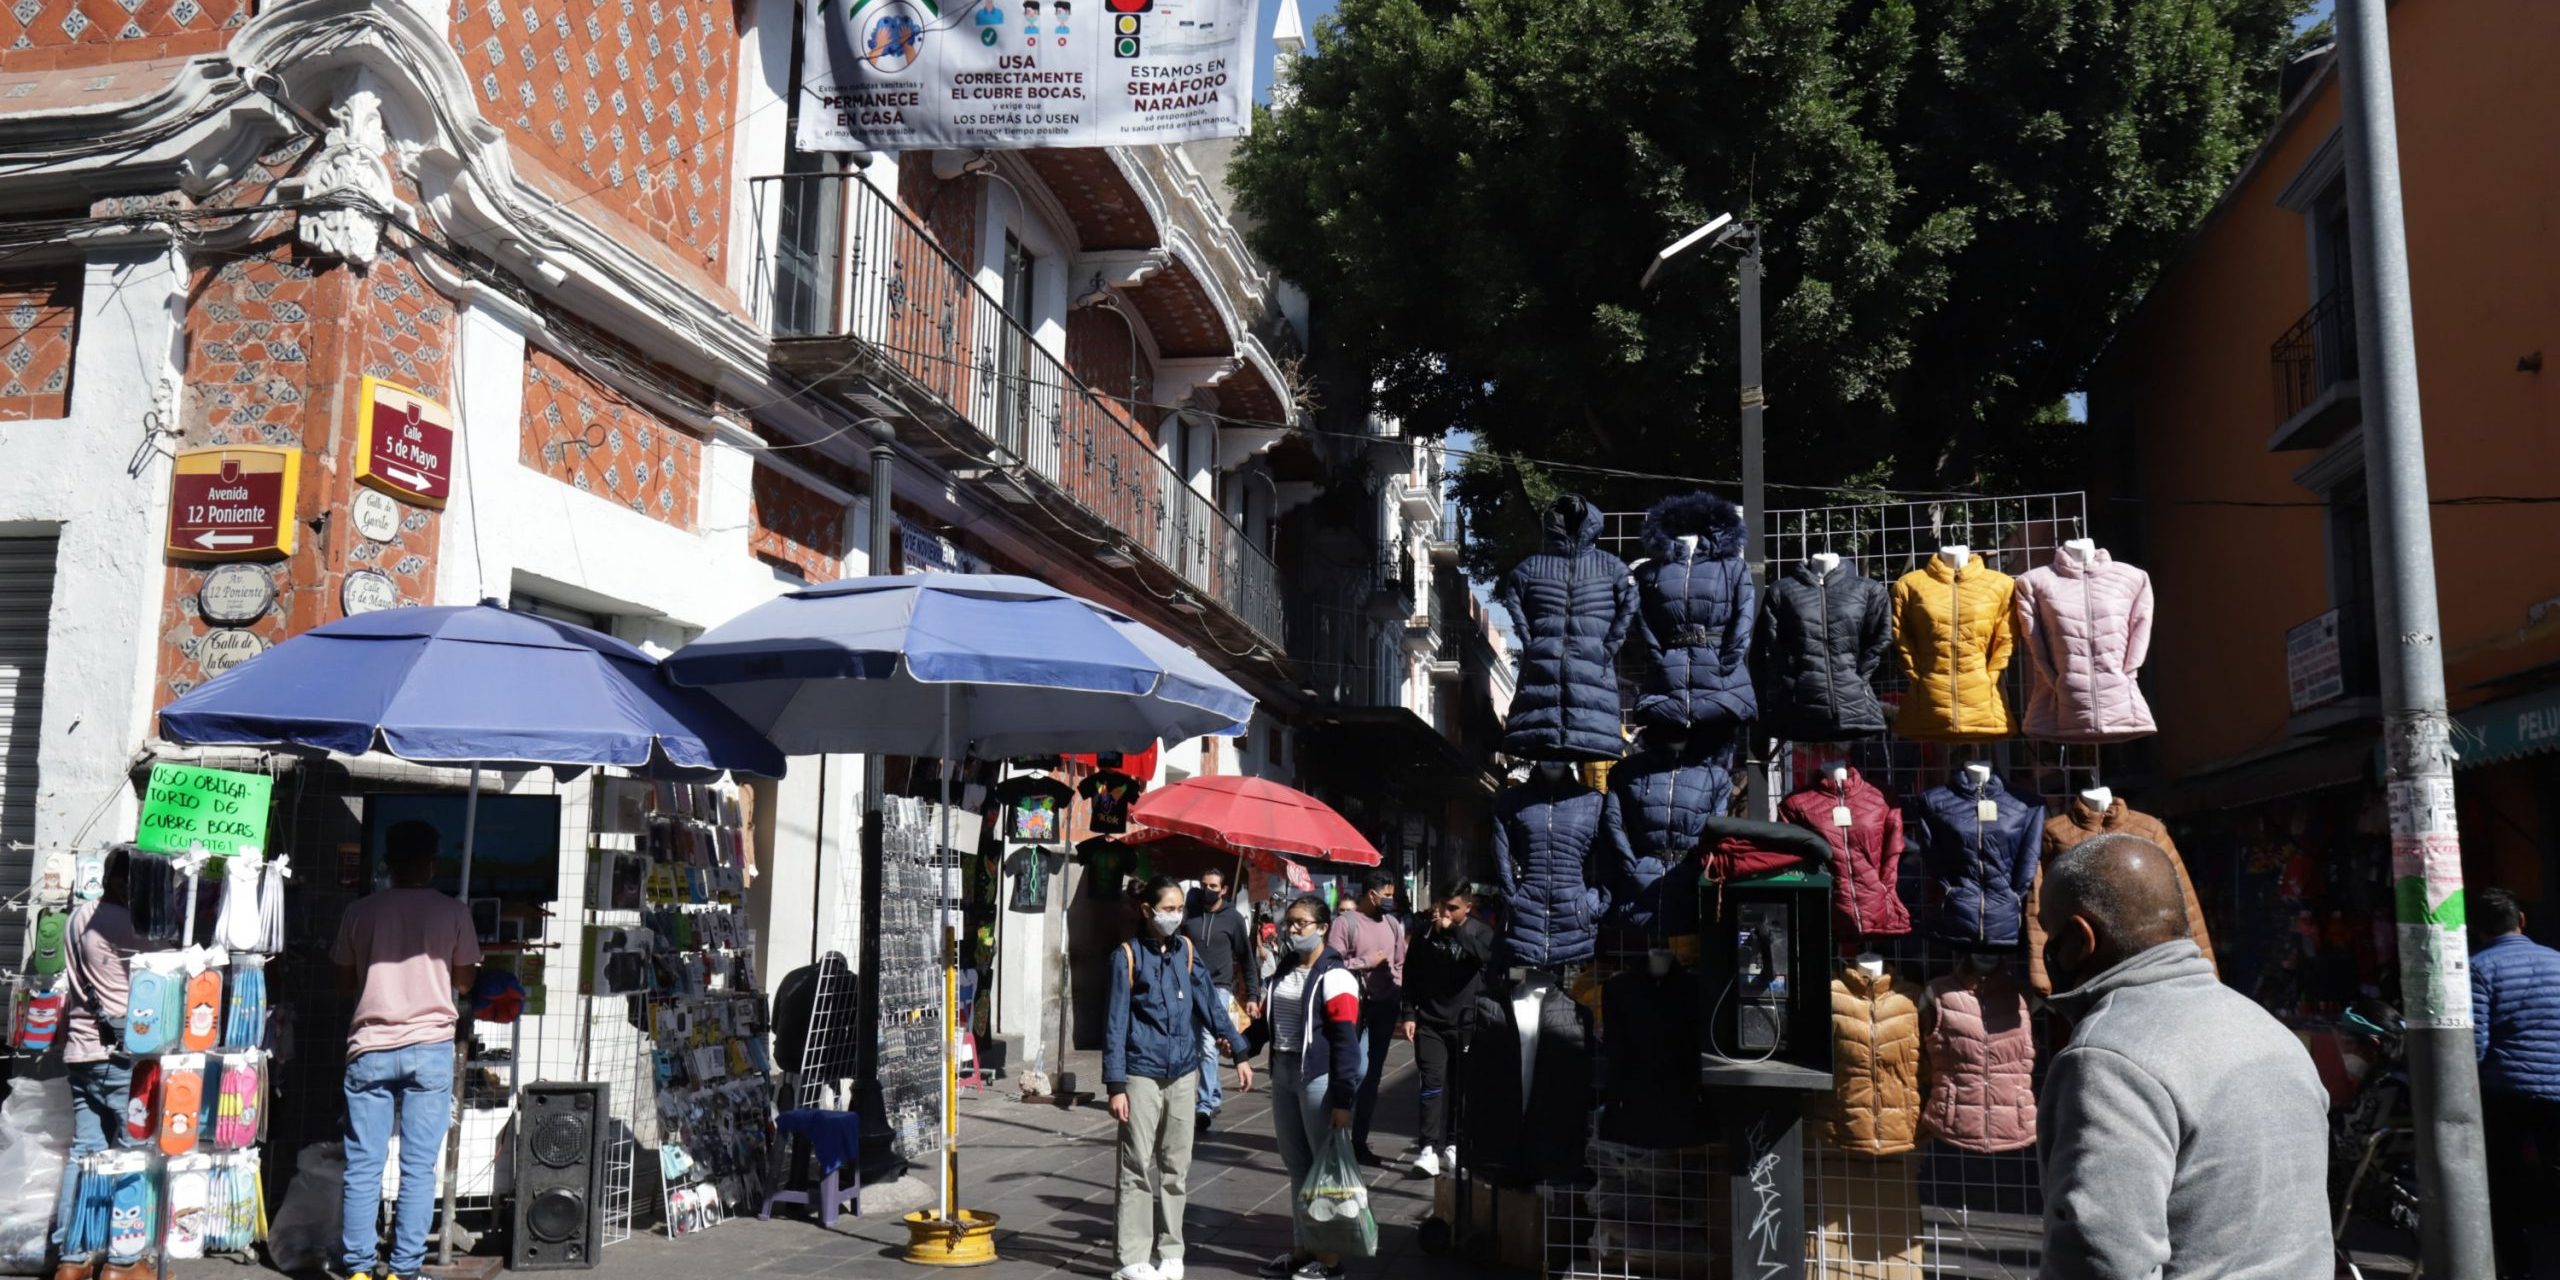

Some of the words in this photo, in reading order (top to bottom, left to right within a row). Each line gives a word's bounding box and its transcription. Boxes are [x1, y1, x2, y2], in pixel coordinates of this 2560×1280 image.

[999, 55, 1036, 69] USA
[1131, 63, 1203, 78] ESTAMOS
[1207, 58, 1226, 73] EN
[954, 72, 1083, 85] CORRECTAMENTE
[1127, 73, 1227, 96] SEMÁFORO
[823, 92, 919, 109] PERMANECE
[951, 88, 969, 99] EL
[973, 87, 1023, 99] CUBRE
[1028, 87, 1086, 101] BOCAS,
[1134, 90, 1219, 112] NARANJA
[1000, 102, 1023, 110] exige
[837, 113, 856, 127] EN
[860, 110, 905, 125] CASA
[953, 115, 976, 125] LOS
[980, 112, 1022, 124] DEMÁS
[1026, 114, 1042, 124] LO
[1046, 114, 1080, 124] USEN
[1132, 124, 1154, 132] salud
[1188, 119, 1200, 127] tus
[966, 127, 974, 135] el
[976, 128, 1002, 136] mayor
[1004, 126, 1034, 136] tiempo
[1037, 126, 1069, 136] posible
[403, 424, 423, 443] Calle
[386, 435, 393, 453] 5
[394, 438, 408, 459] de
[409, 444, 437, 471] Mayo
[208, 486, 249, 501] Avenida
[187, 505, 204, 523] 12
[208, 503, 266, 523] Poniente
[208, 586, 222, 599] 12
[223, 585, 264, 599] Poniente
[241, 634, 253, 649] de
[150, 787, 200, 810] TORIO
[214, 798, 238, 815] DE
[144, 813, 197, 832] CUBRE
